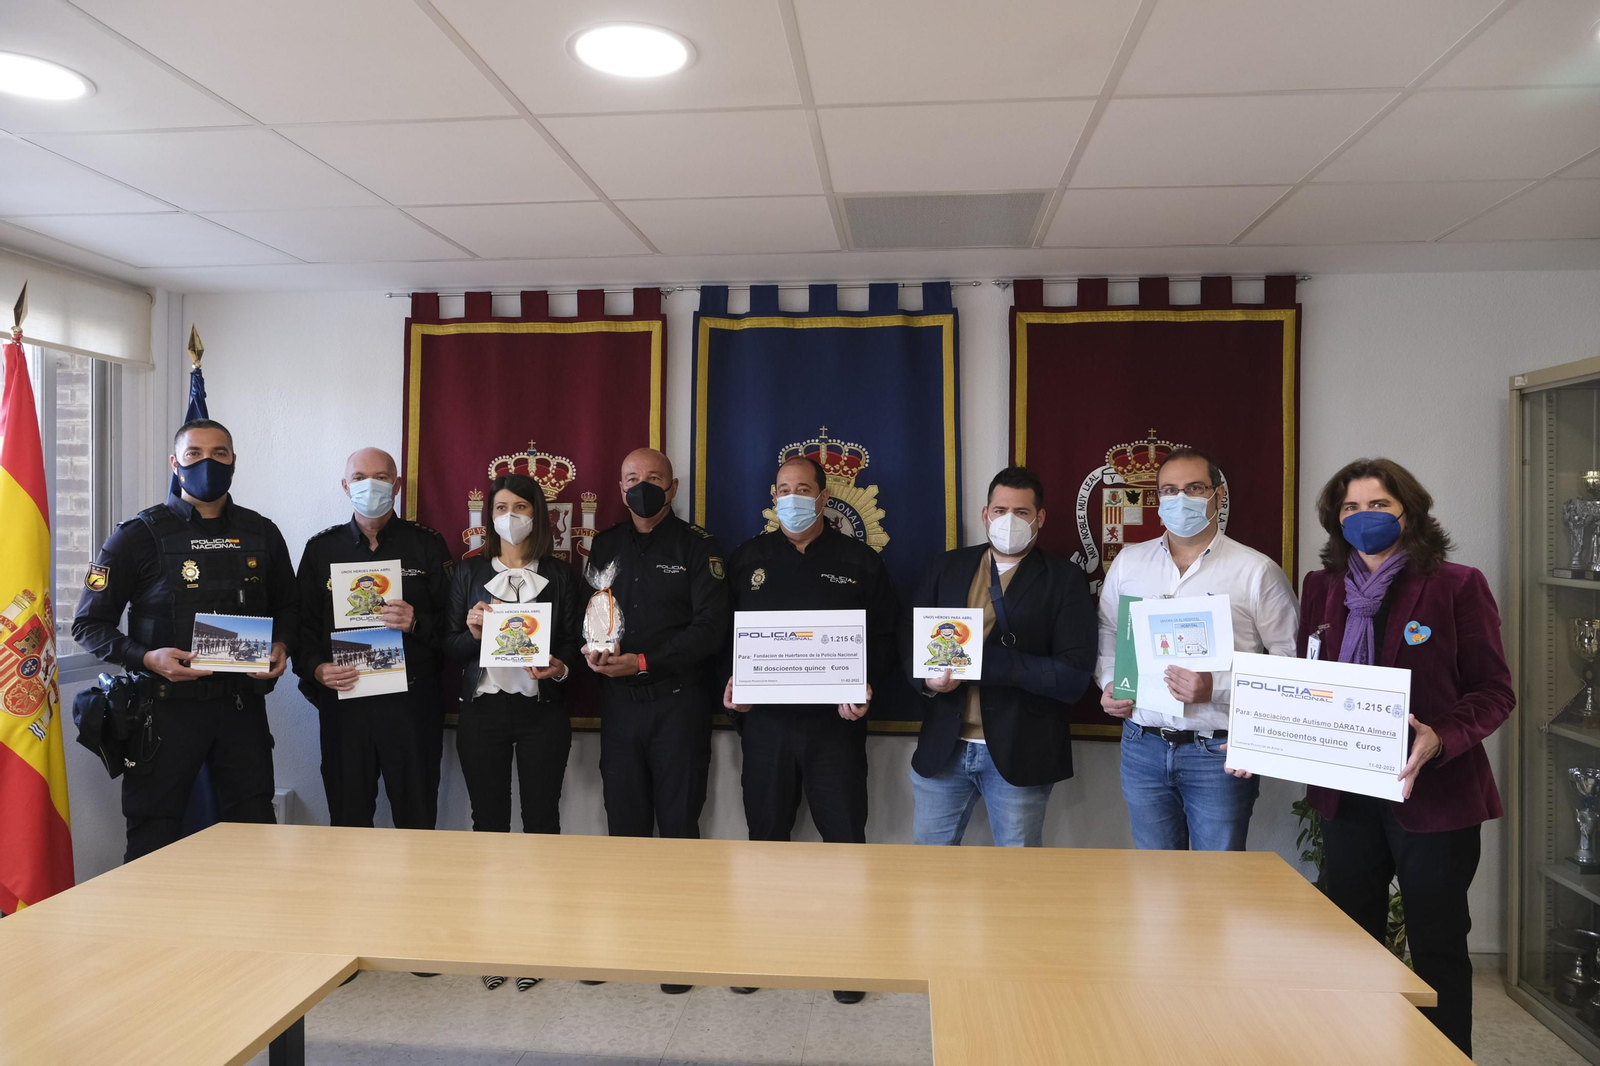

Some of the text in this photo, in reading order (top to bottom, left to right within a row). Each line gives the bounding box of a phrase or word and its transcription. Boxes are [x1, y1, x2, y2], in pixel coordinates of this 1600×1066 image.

[1109, 475, 1116, 483] Y
[826, 498, 861, 529] CIONAL
[1077, 473, 1101, 560] MUY NOBLE MUY LEAL
[1218, 512, 1227, 524] LA
[575, 529, 596, 538] VLTR
[738, 631, 797, 639] POLICIA
[804, 665, 826, 673] quince
[1236, 679, 1312, 696] POLICIA
[1280, 692, 1333, 704] NACIONAL
[1356, 701, 1392, 714] 1.215 €
[1235, 707, 1252, 716] Para:
[1253, 710, 1291, 722] Asociacion
[1302, 717, 1332, 728] Autismo
[1333, 721, 1366, 733] DÁRATA
[1253, 725, 1382, 753] Mil doscioentos quince €uros
[1368, 762, 1396, 772] 11-02-2022
